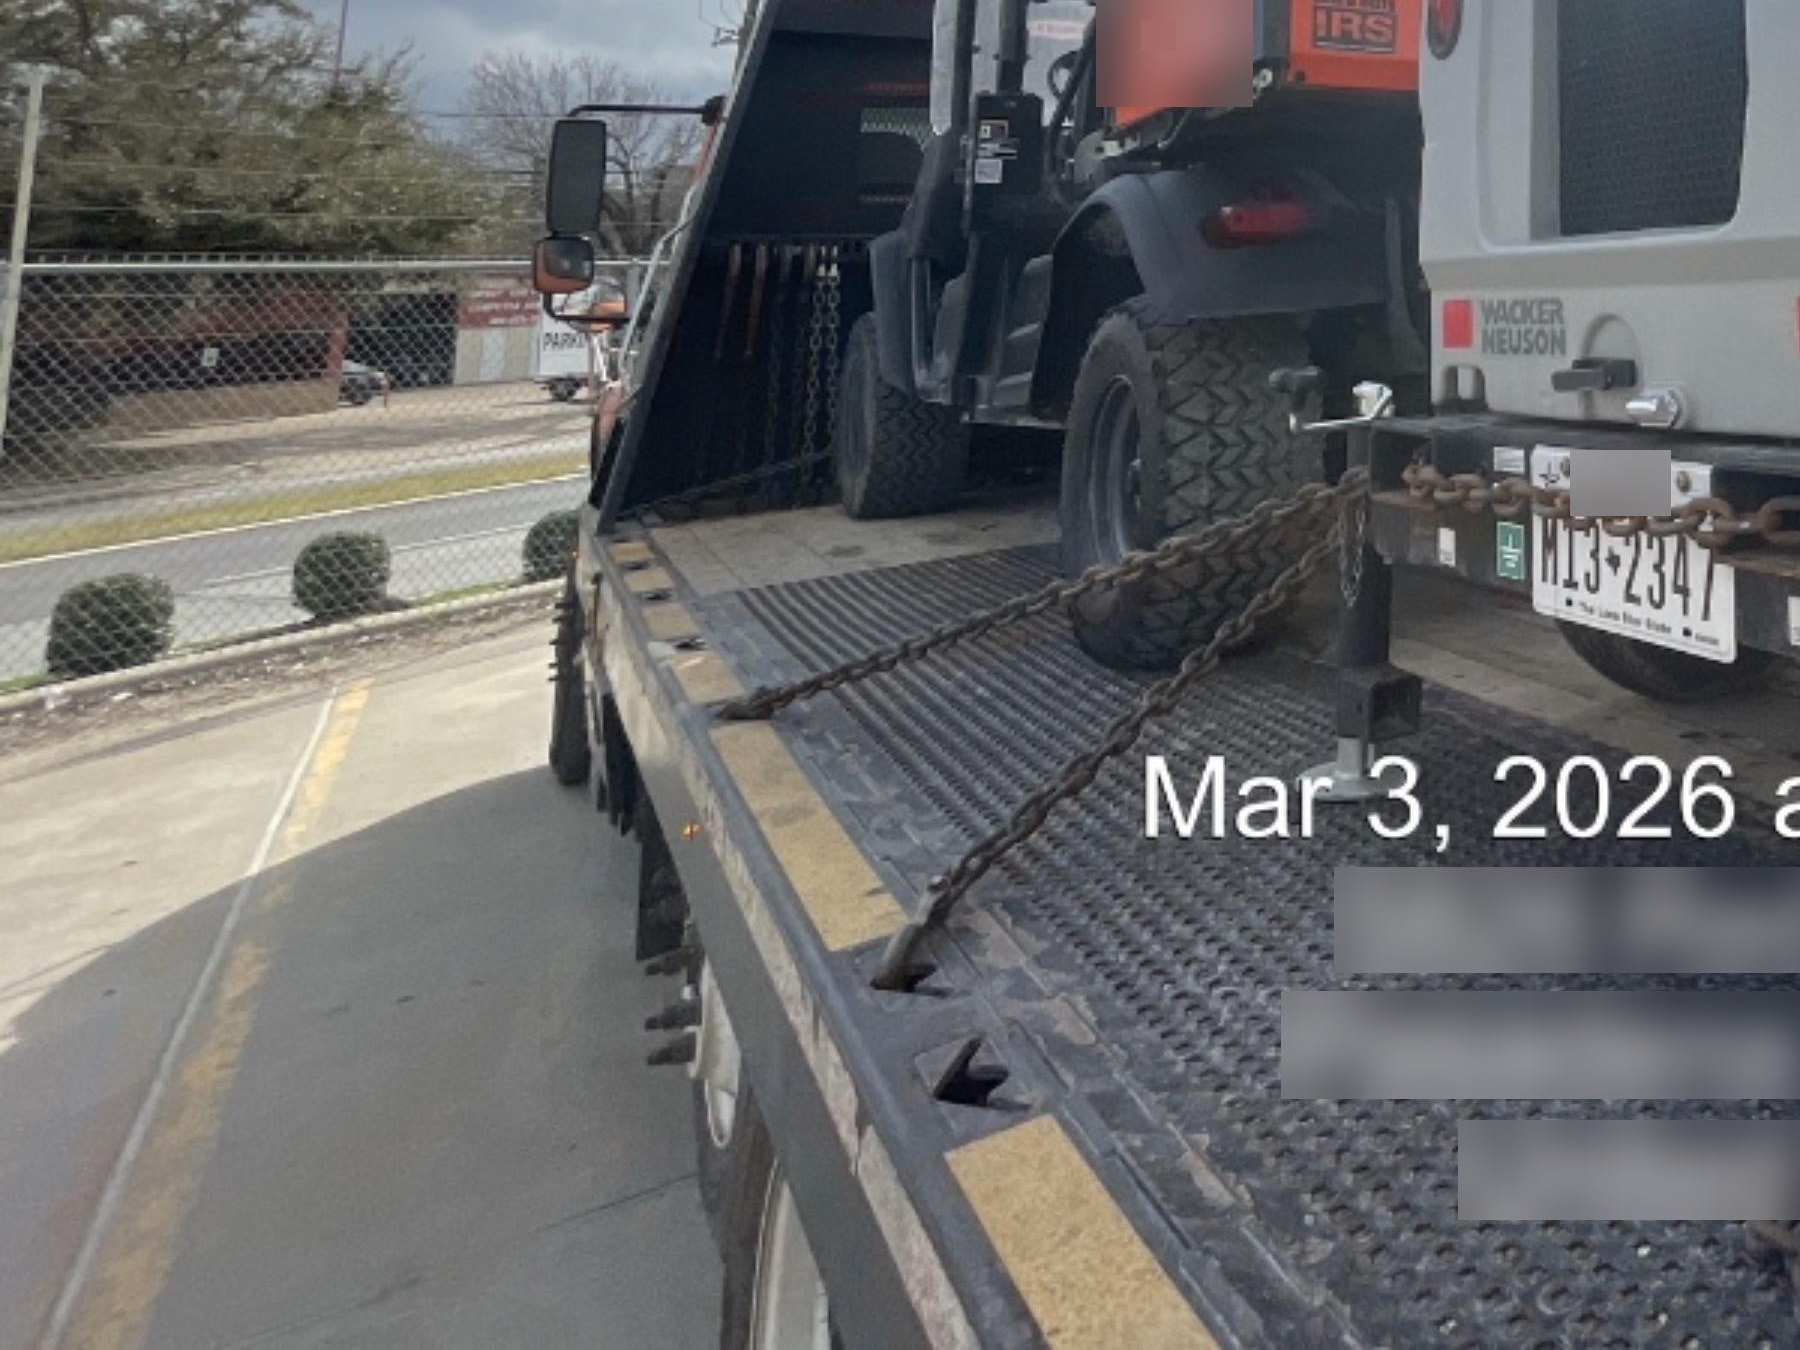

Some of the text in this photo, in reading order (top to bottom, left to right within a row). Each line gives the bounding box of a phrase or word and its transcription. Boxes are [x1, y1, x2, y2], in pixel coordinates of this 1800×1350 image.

[1315, 8, 1394, 44] IRS
[1480, 298, 1564, 325] WACKER
[1481, 327, 1567, 355] NEUSON
